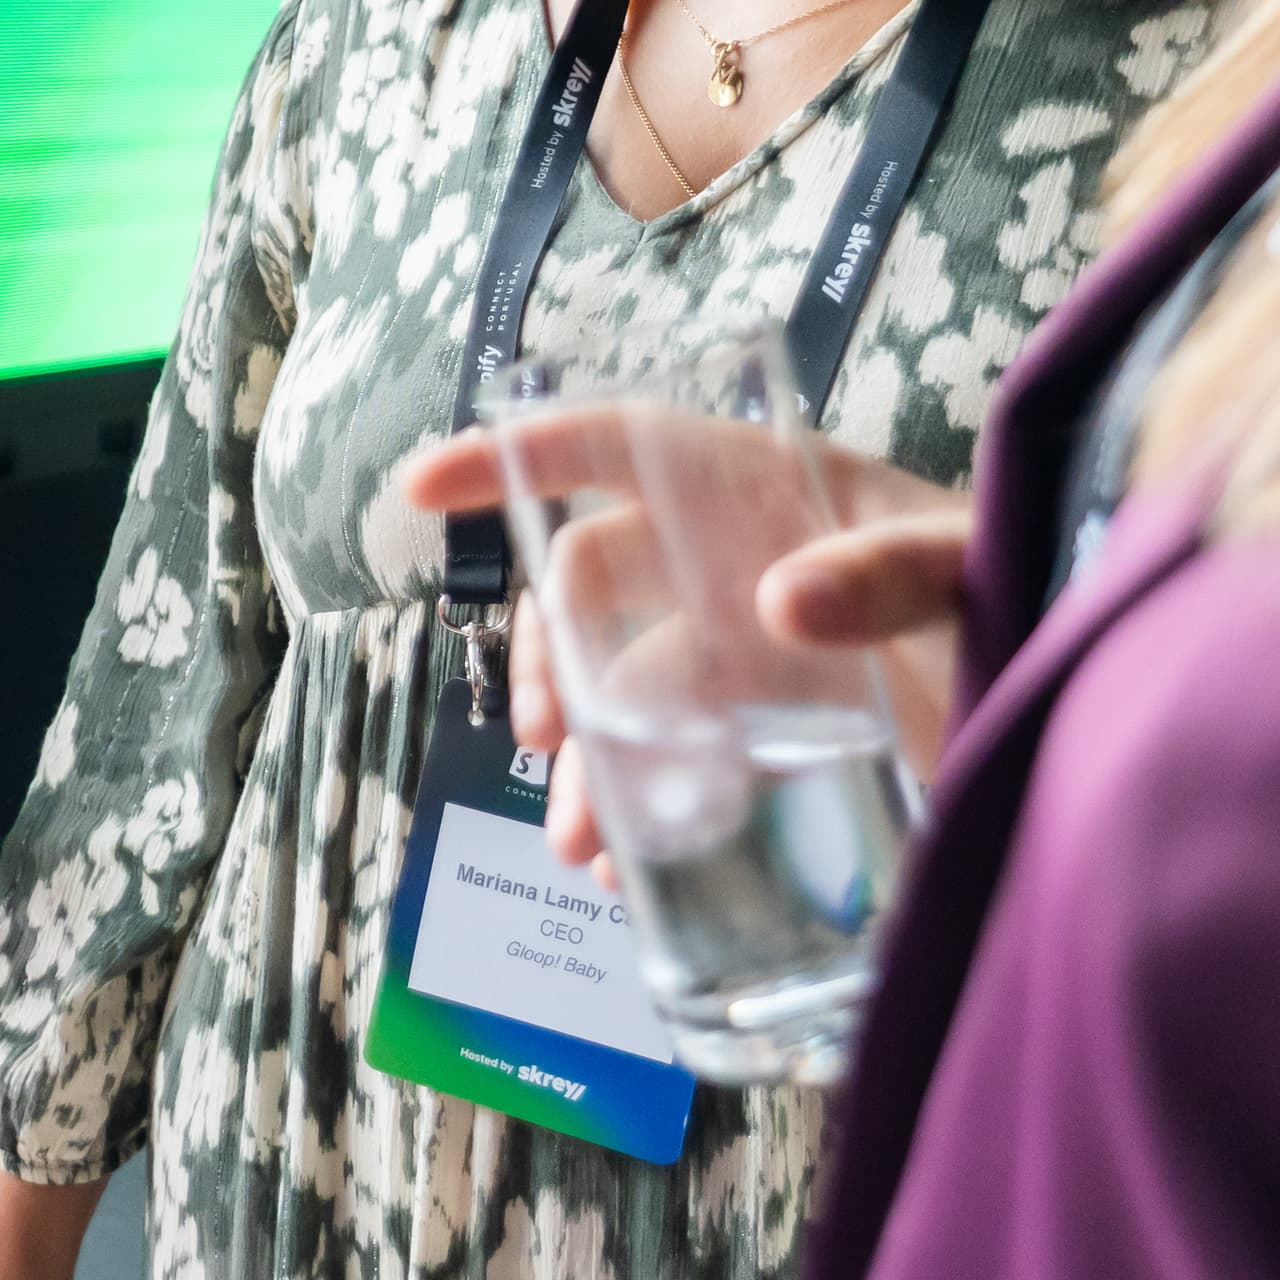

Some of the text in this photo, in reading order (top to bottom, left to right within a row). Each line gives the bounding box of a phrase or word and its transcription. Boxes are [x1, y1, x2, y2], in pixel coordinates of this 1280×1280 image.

[530, 147, 556, 189] Hosted
[549, 131, 564, 147] by
[870, 160, 899, 203] Hosted
[859, 199, 882, 219] by
[485, 270, 507, 332] CONNECT
[497, 260, 523, 332] PORTUGAL
[456, 863, 537, 902] Mariana
[544, 886, 602, 922] Lamy
[539, 919, 584, 946] CEO
[506, 940, 608, 984] Gloop! Baby
[460, 1046, 498, 1069] Hosted
[500, 1056, 515, 1075] by
